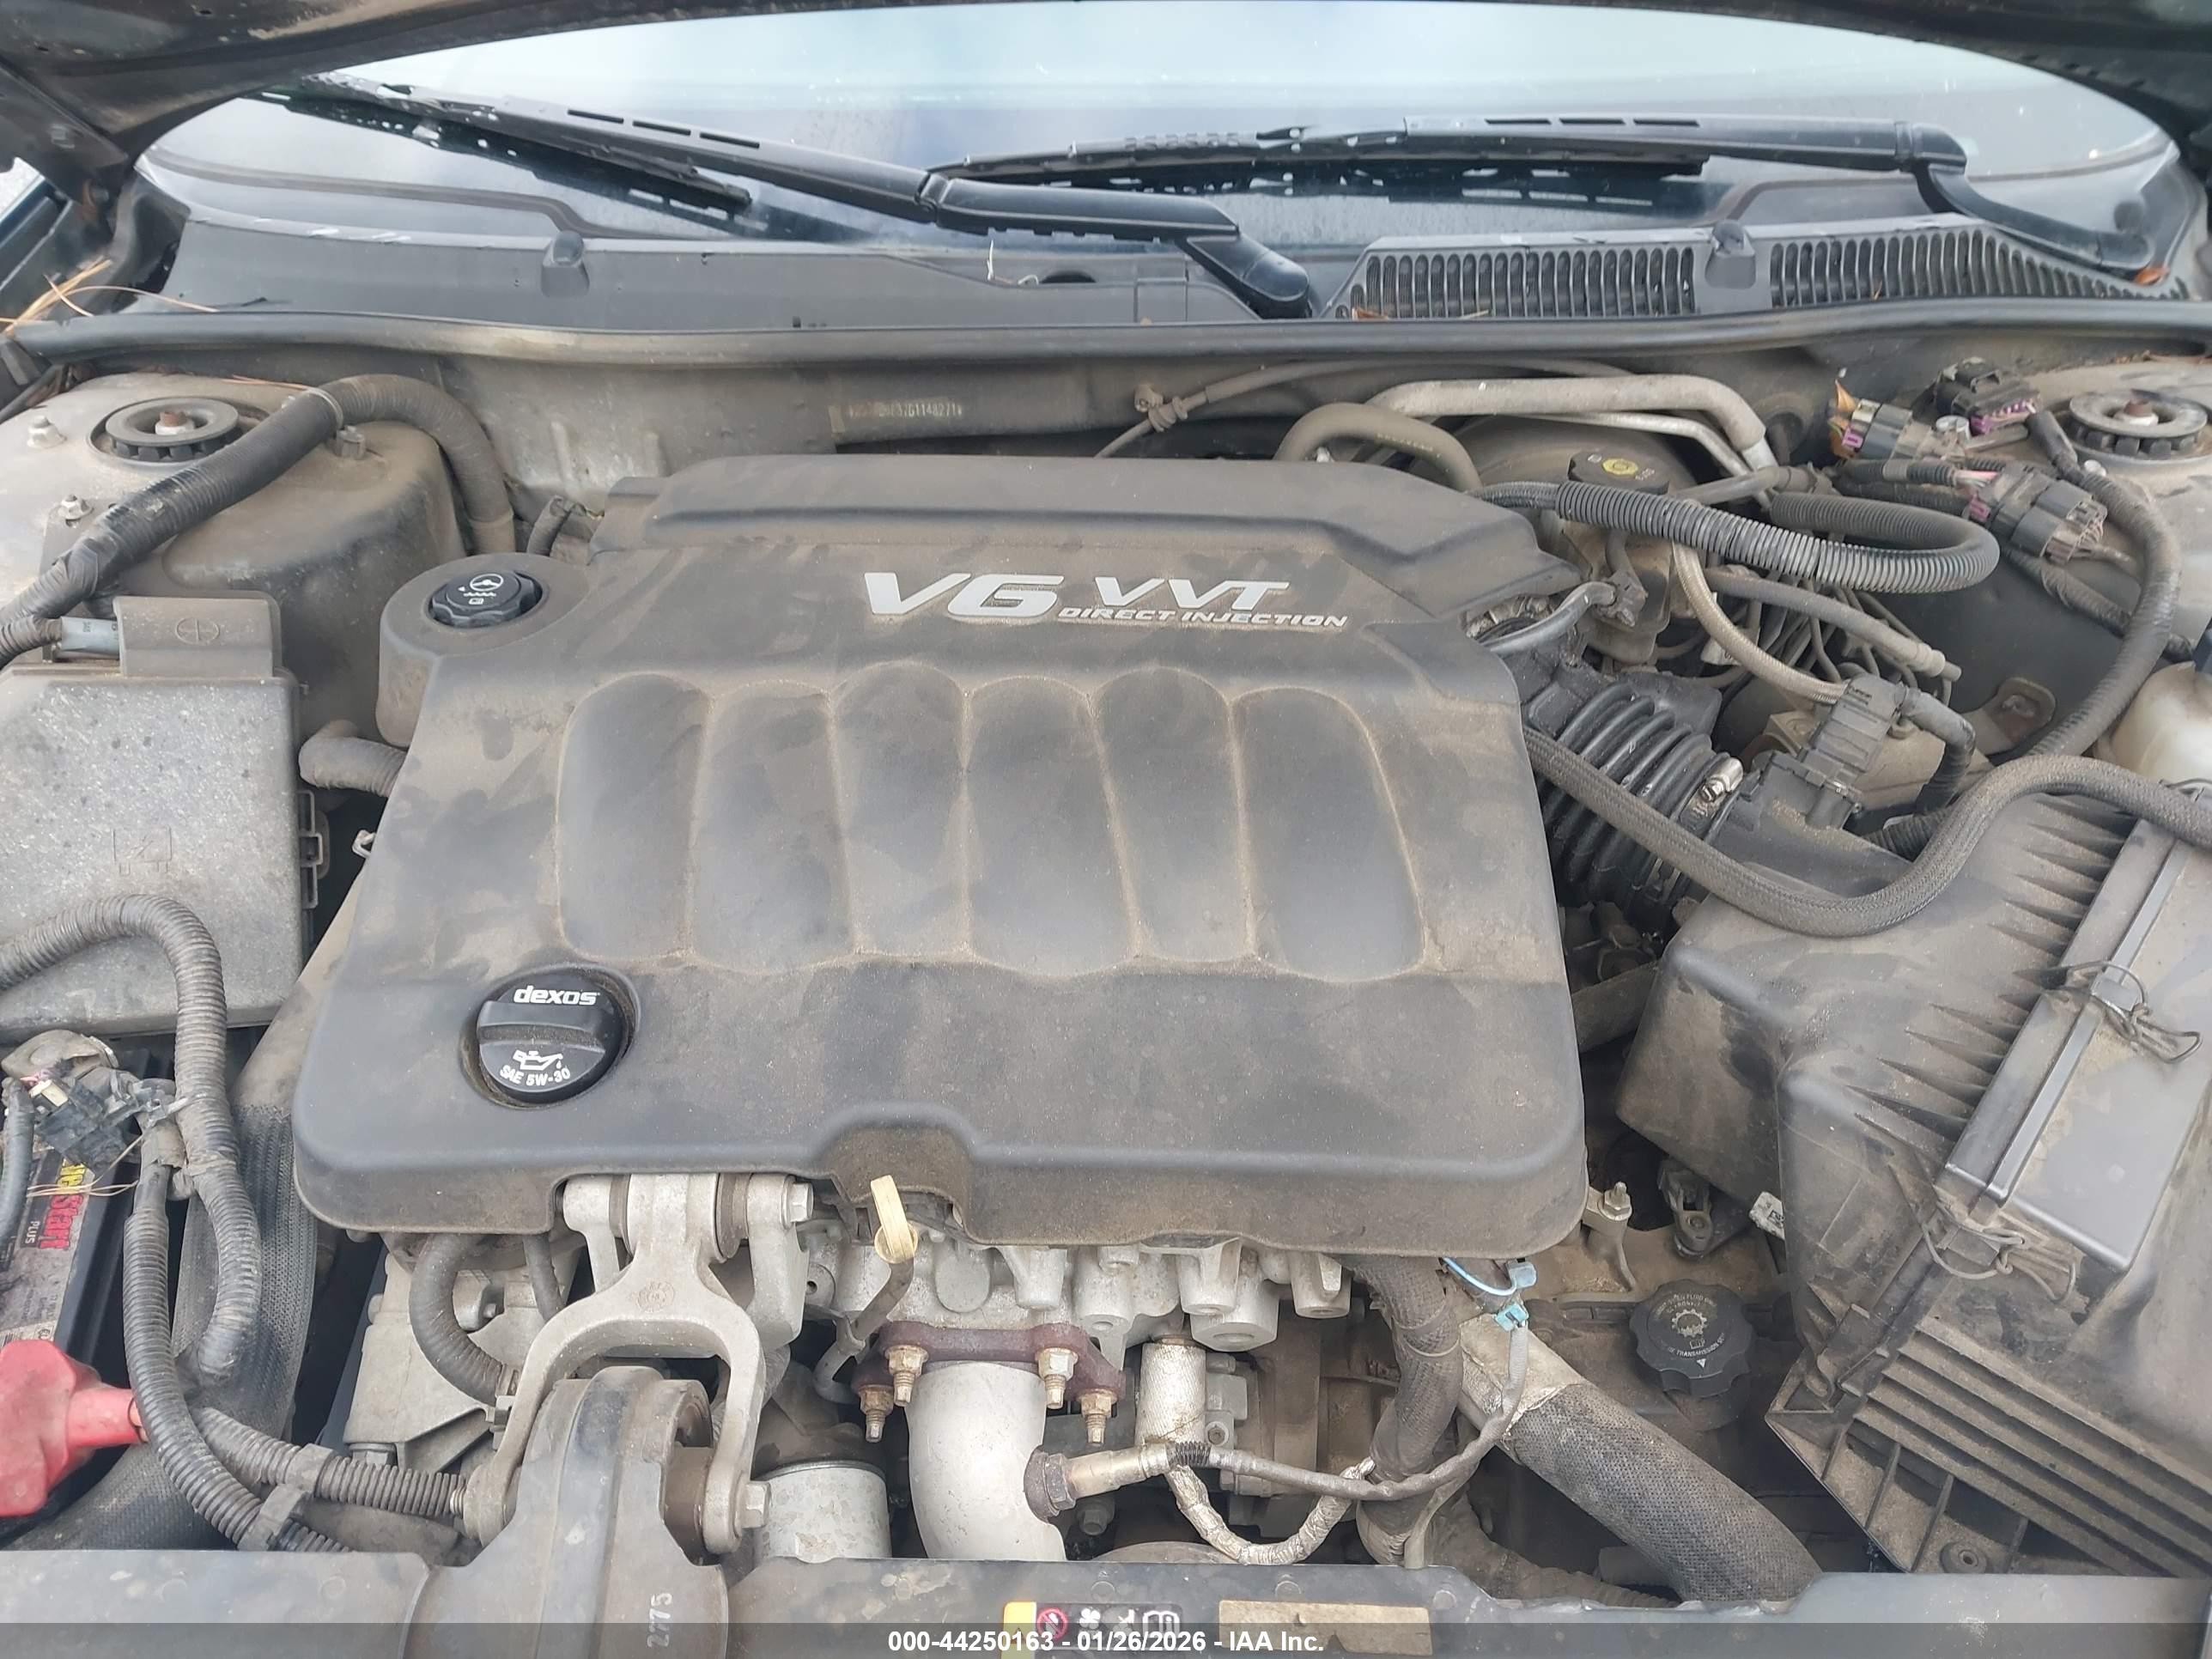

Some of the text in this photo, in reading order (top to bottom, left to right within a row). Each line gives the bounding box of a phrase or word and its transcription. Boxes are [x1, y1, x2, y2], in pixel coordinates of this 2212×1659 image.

[864, 573, 1291, 618] V6 VVT
[1058, 606, 1350, 629] DIRECT INJECTION
[514, 985, 599, 1006] dexos
[500, 1065, 571, 1086] SAE 5W-30
[25, 1220, 40, 1244] PLUS
